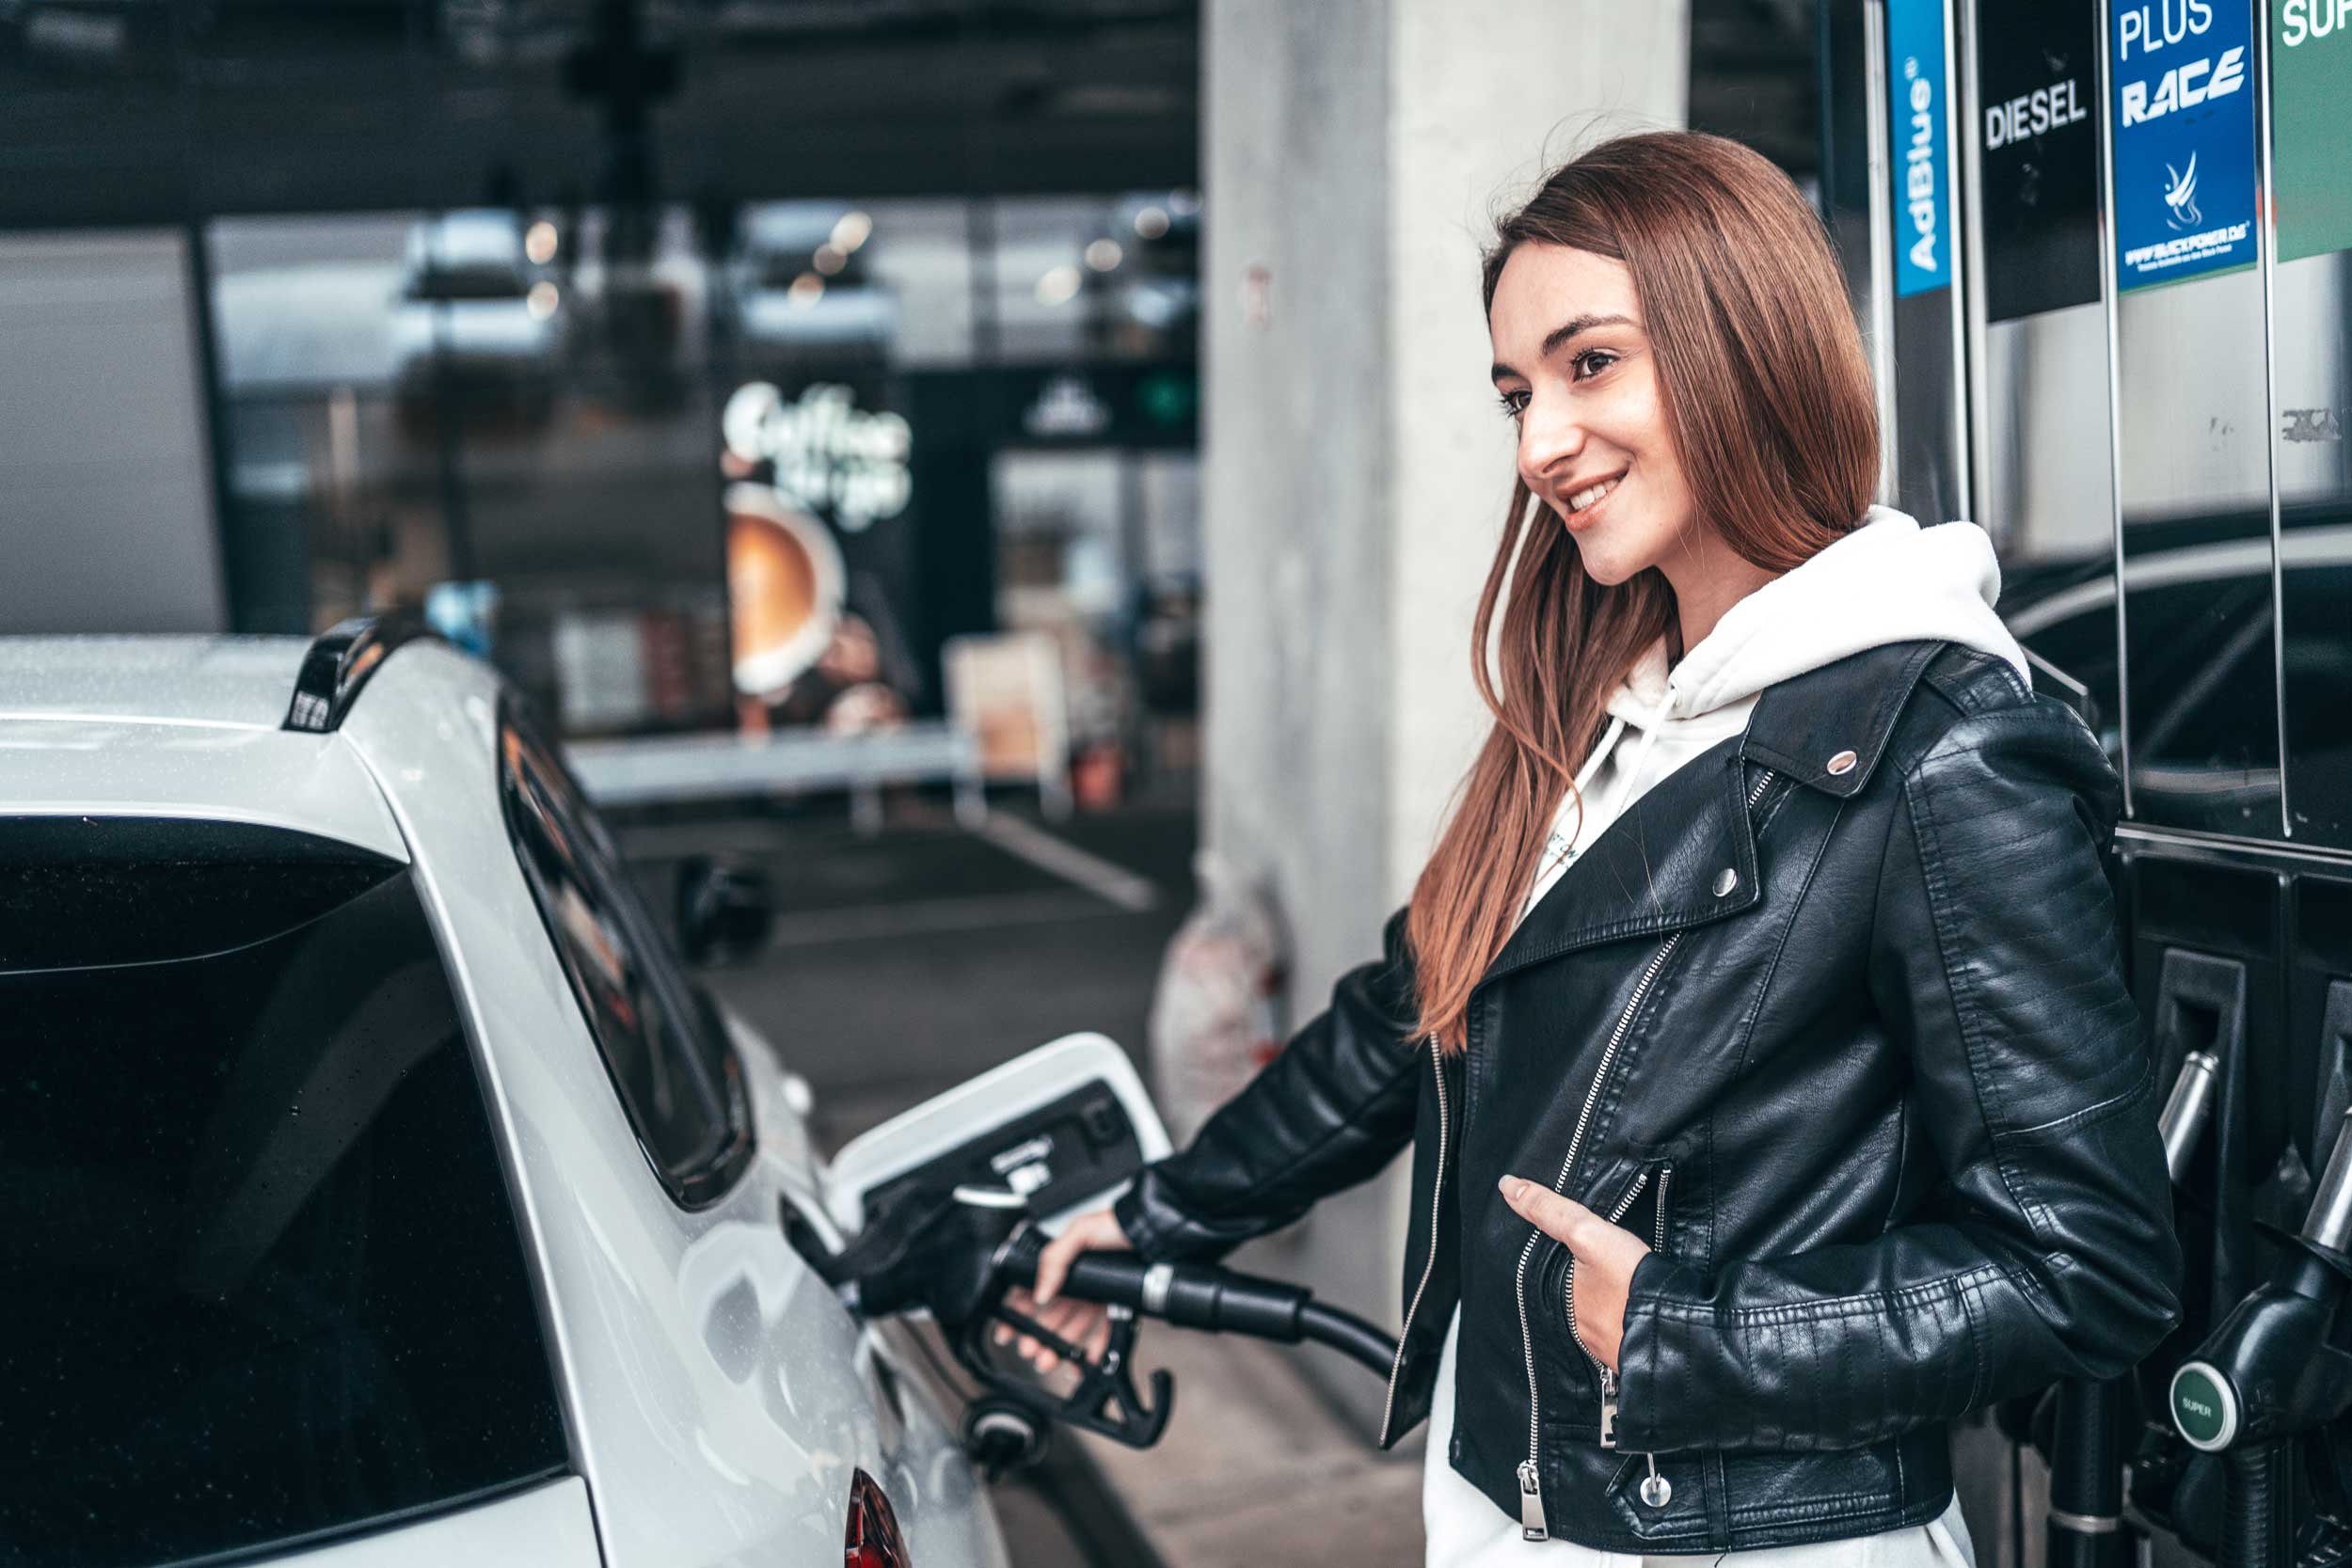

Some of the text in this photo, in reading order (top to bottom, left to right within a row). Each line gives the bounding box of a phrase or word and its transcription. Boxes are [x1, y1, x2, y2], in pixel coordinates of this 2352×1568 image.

[2121, 0, 2213, 62] PLUS
[1985, 78, 2088, 150] DIESEL
[2122, 45, 2245, 128] RACE
[2183, 1397, 2212, 1418] SUPER
